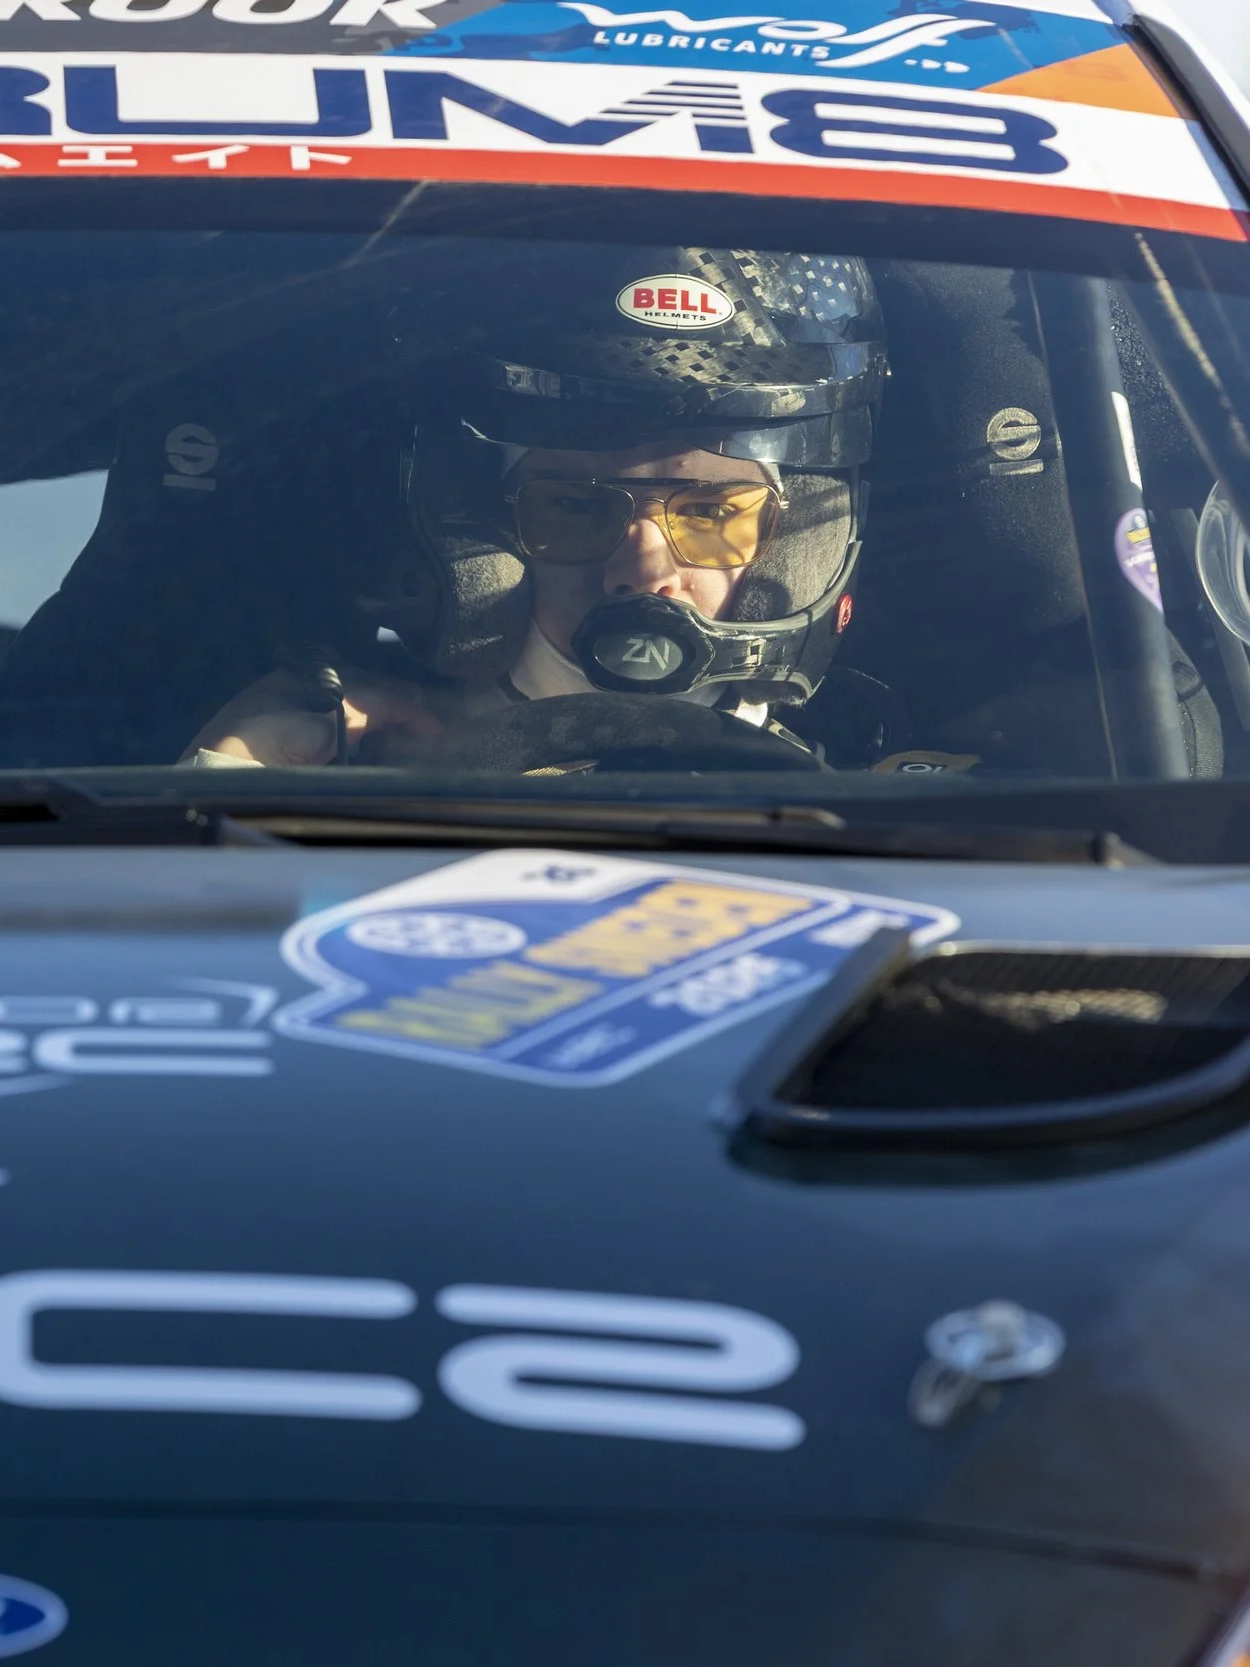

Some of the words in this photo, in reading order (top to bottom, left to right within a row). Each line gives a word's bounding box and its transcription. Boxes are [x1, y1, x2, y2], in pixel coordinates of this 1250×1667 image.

[593, 31, 831, 60] LUBRICANTS
[633, 287, 718, 314] BELL
[644, 310, 707, 321] HELMETS
